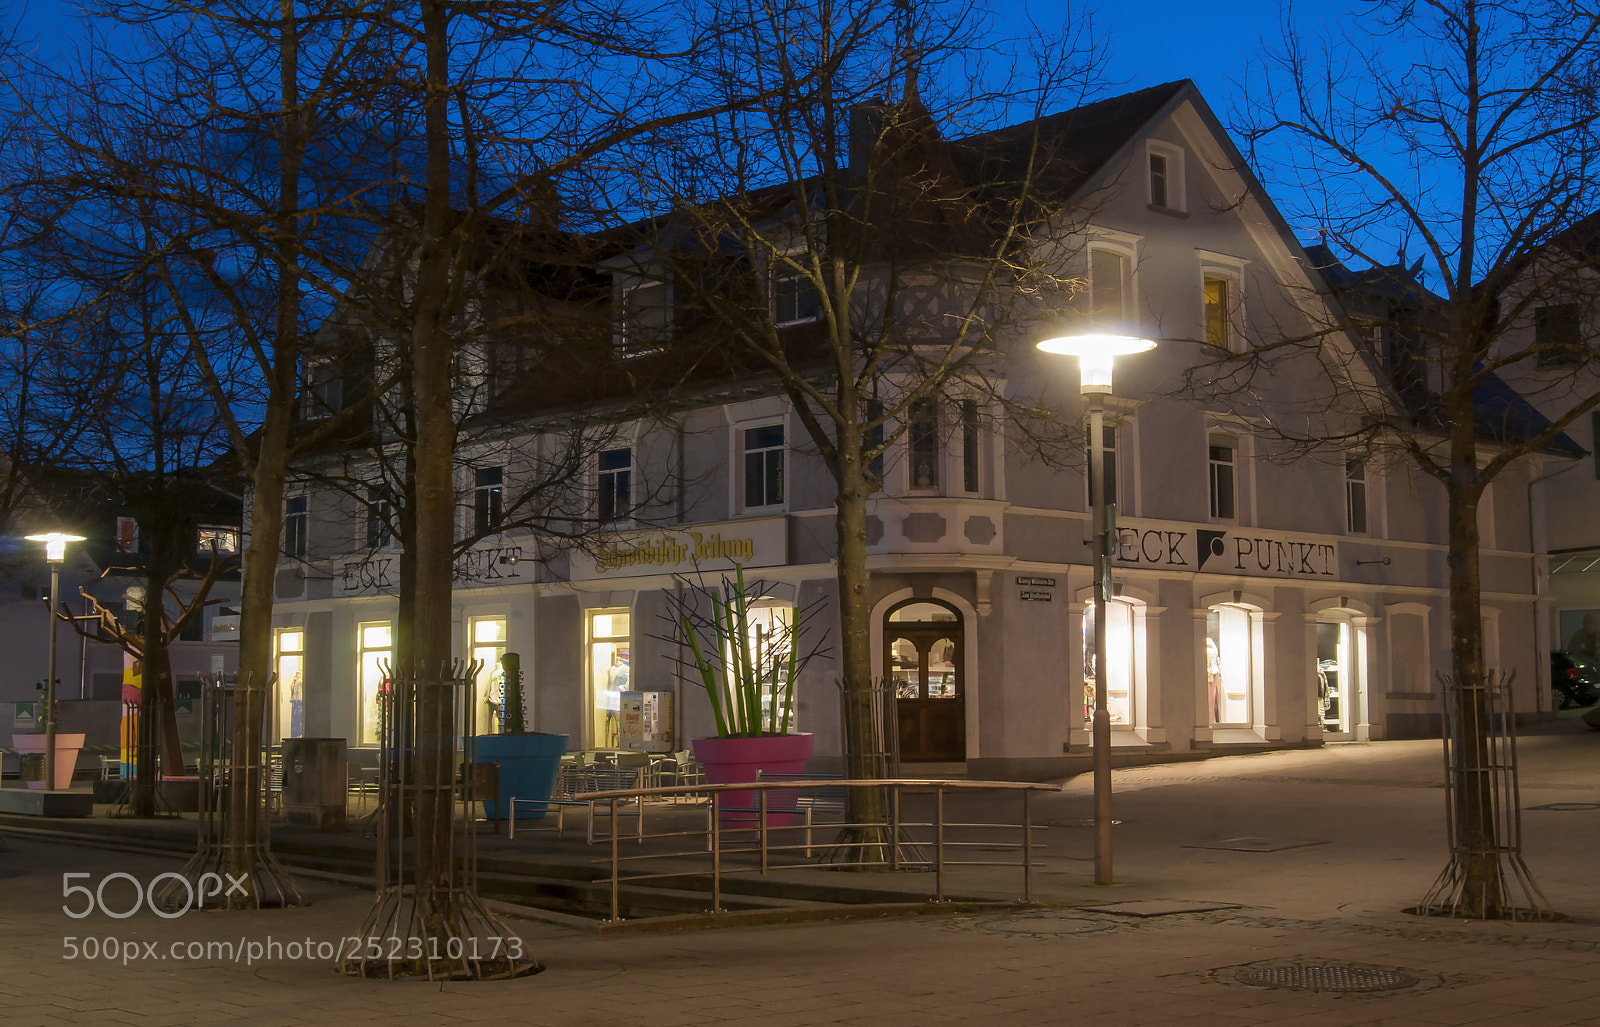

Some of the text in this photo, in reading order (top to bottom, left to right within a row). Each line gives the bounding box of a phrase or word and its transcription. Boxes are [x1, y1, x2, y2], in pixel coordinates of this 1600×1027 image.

[343, 546, 522, 591] ECK NKT
[688, 531, 754, 567] Zeitung
[1116, 527, 1335, 576] ECK PUNKT
